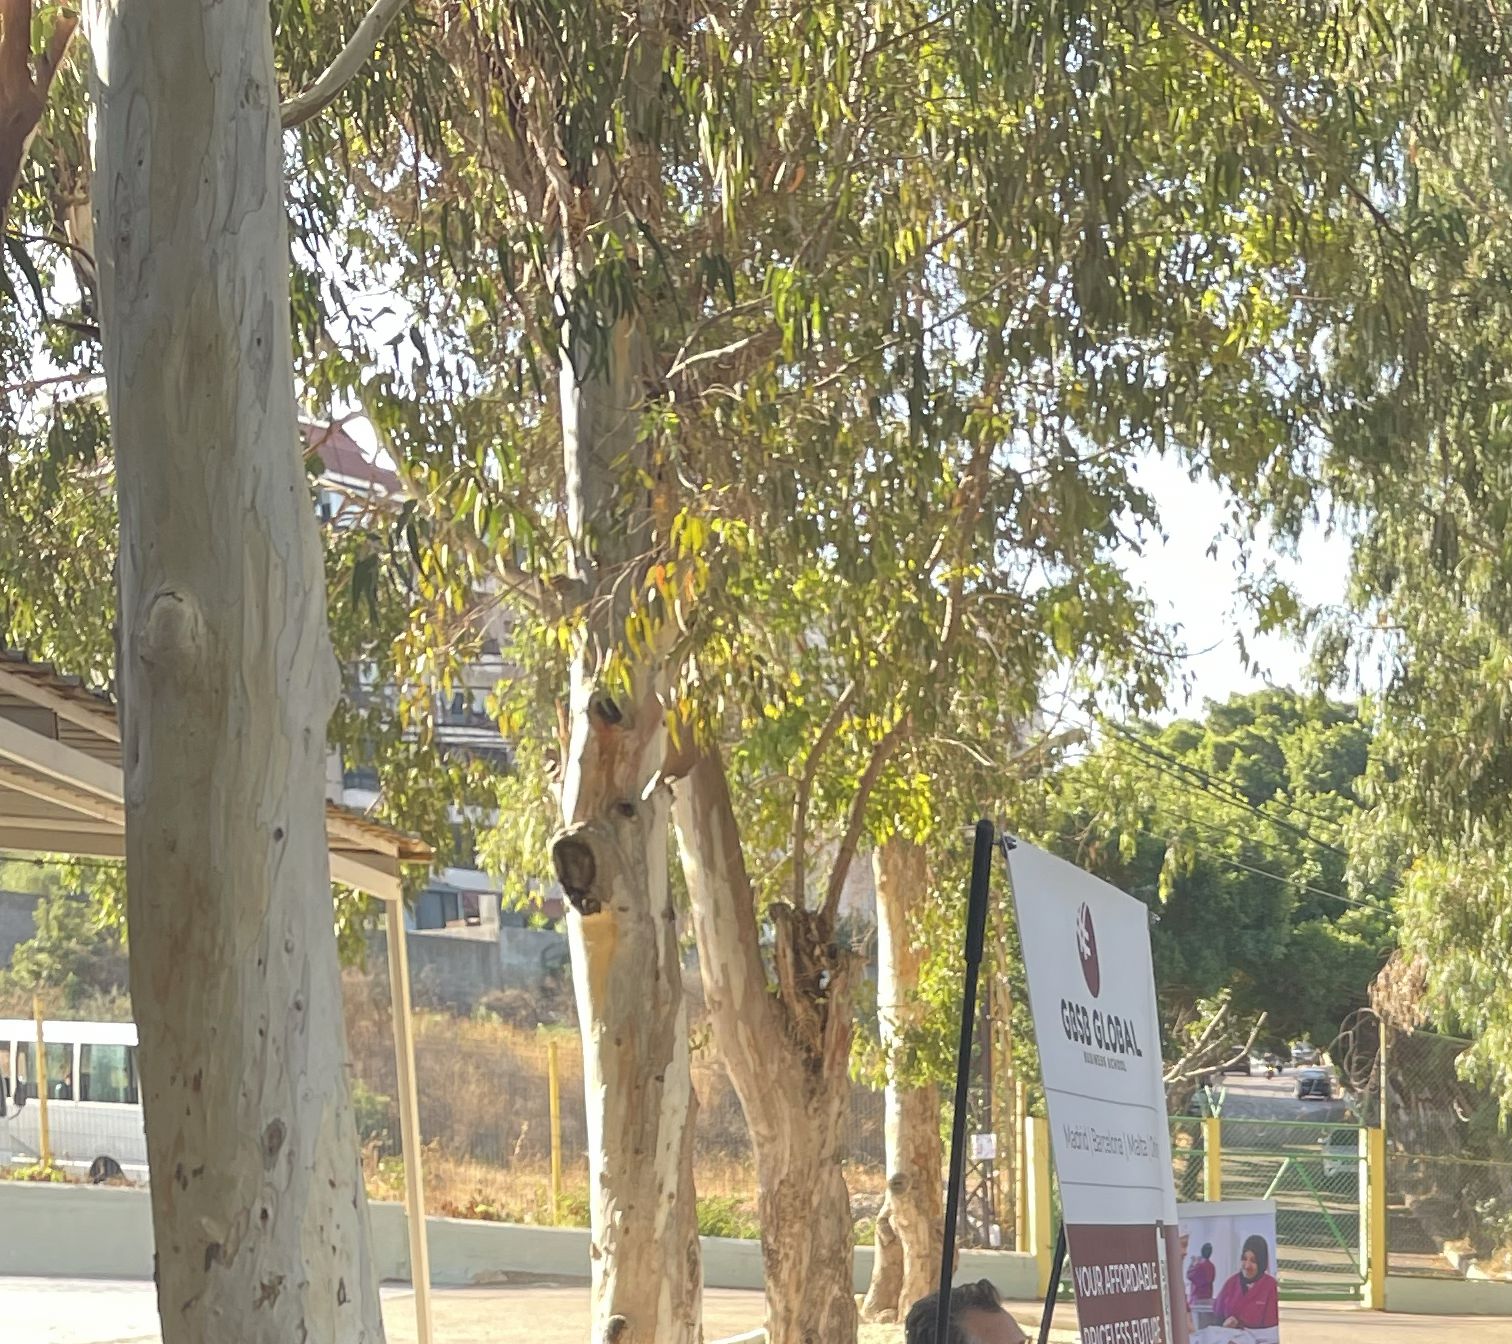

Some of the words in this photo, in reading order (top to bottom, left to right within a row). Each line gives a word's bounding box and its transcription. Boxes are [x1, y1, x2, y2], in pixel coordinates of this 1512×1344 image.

[1061, 998, 1092, 1046] GBSB
[1092, 1009, 1143, 1057] GLOBAL
[1063, 1123, 1089, 1151] Madrid
[1090, 1127, 1124, 1156] Barcelona
[1075, 1265, 1104, 1298] YOUR
[1104, 1261, 1158, 1295] AFFORDABLE
